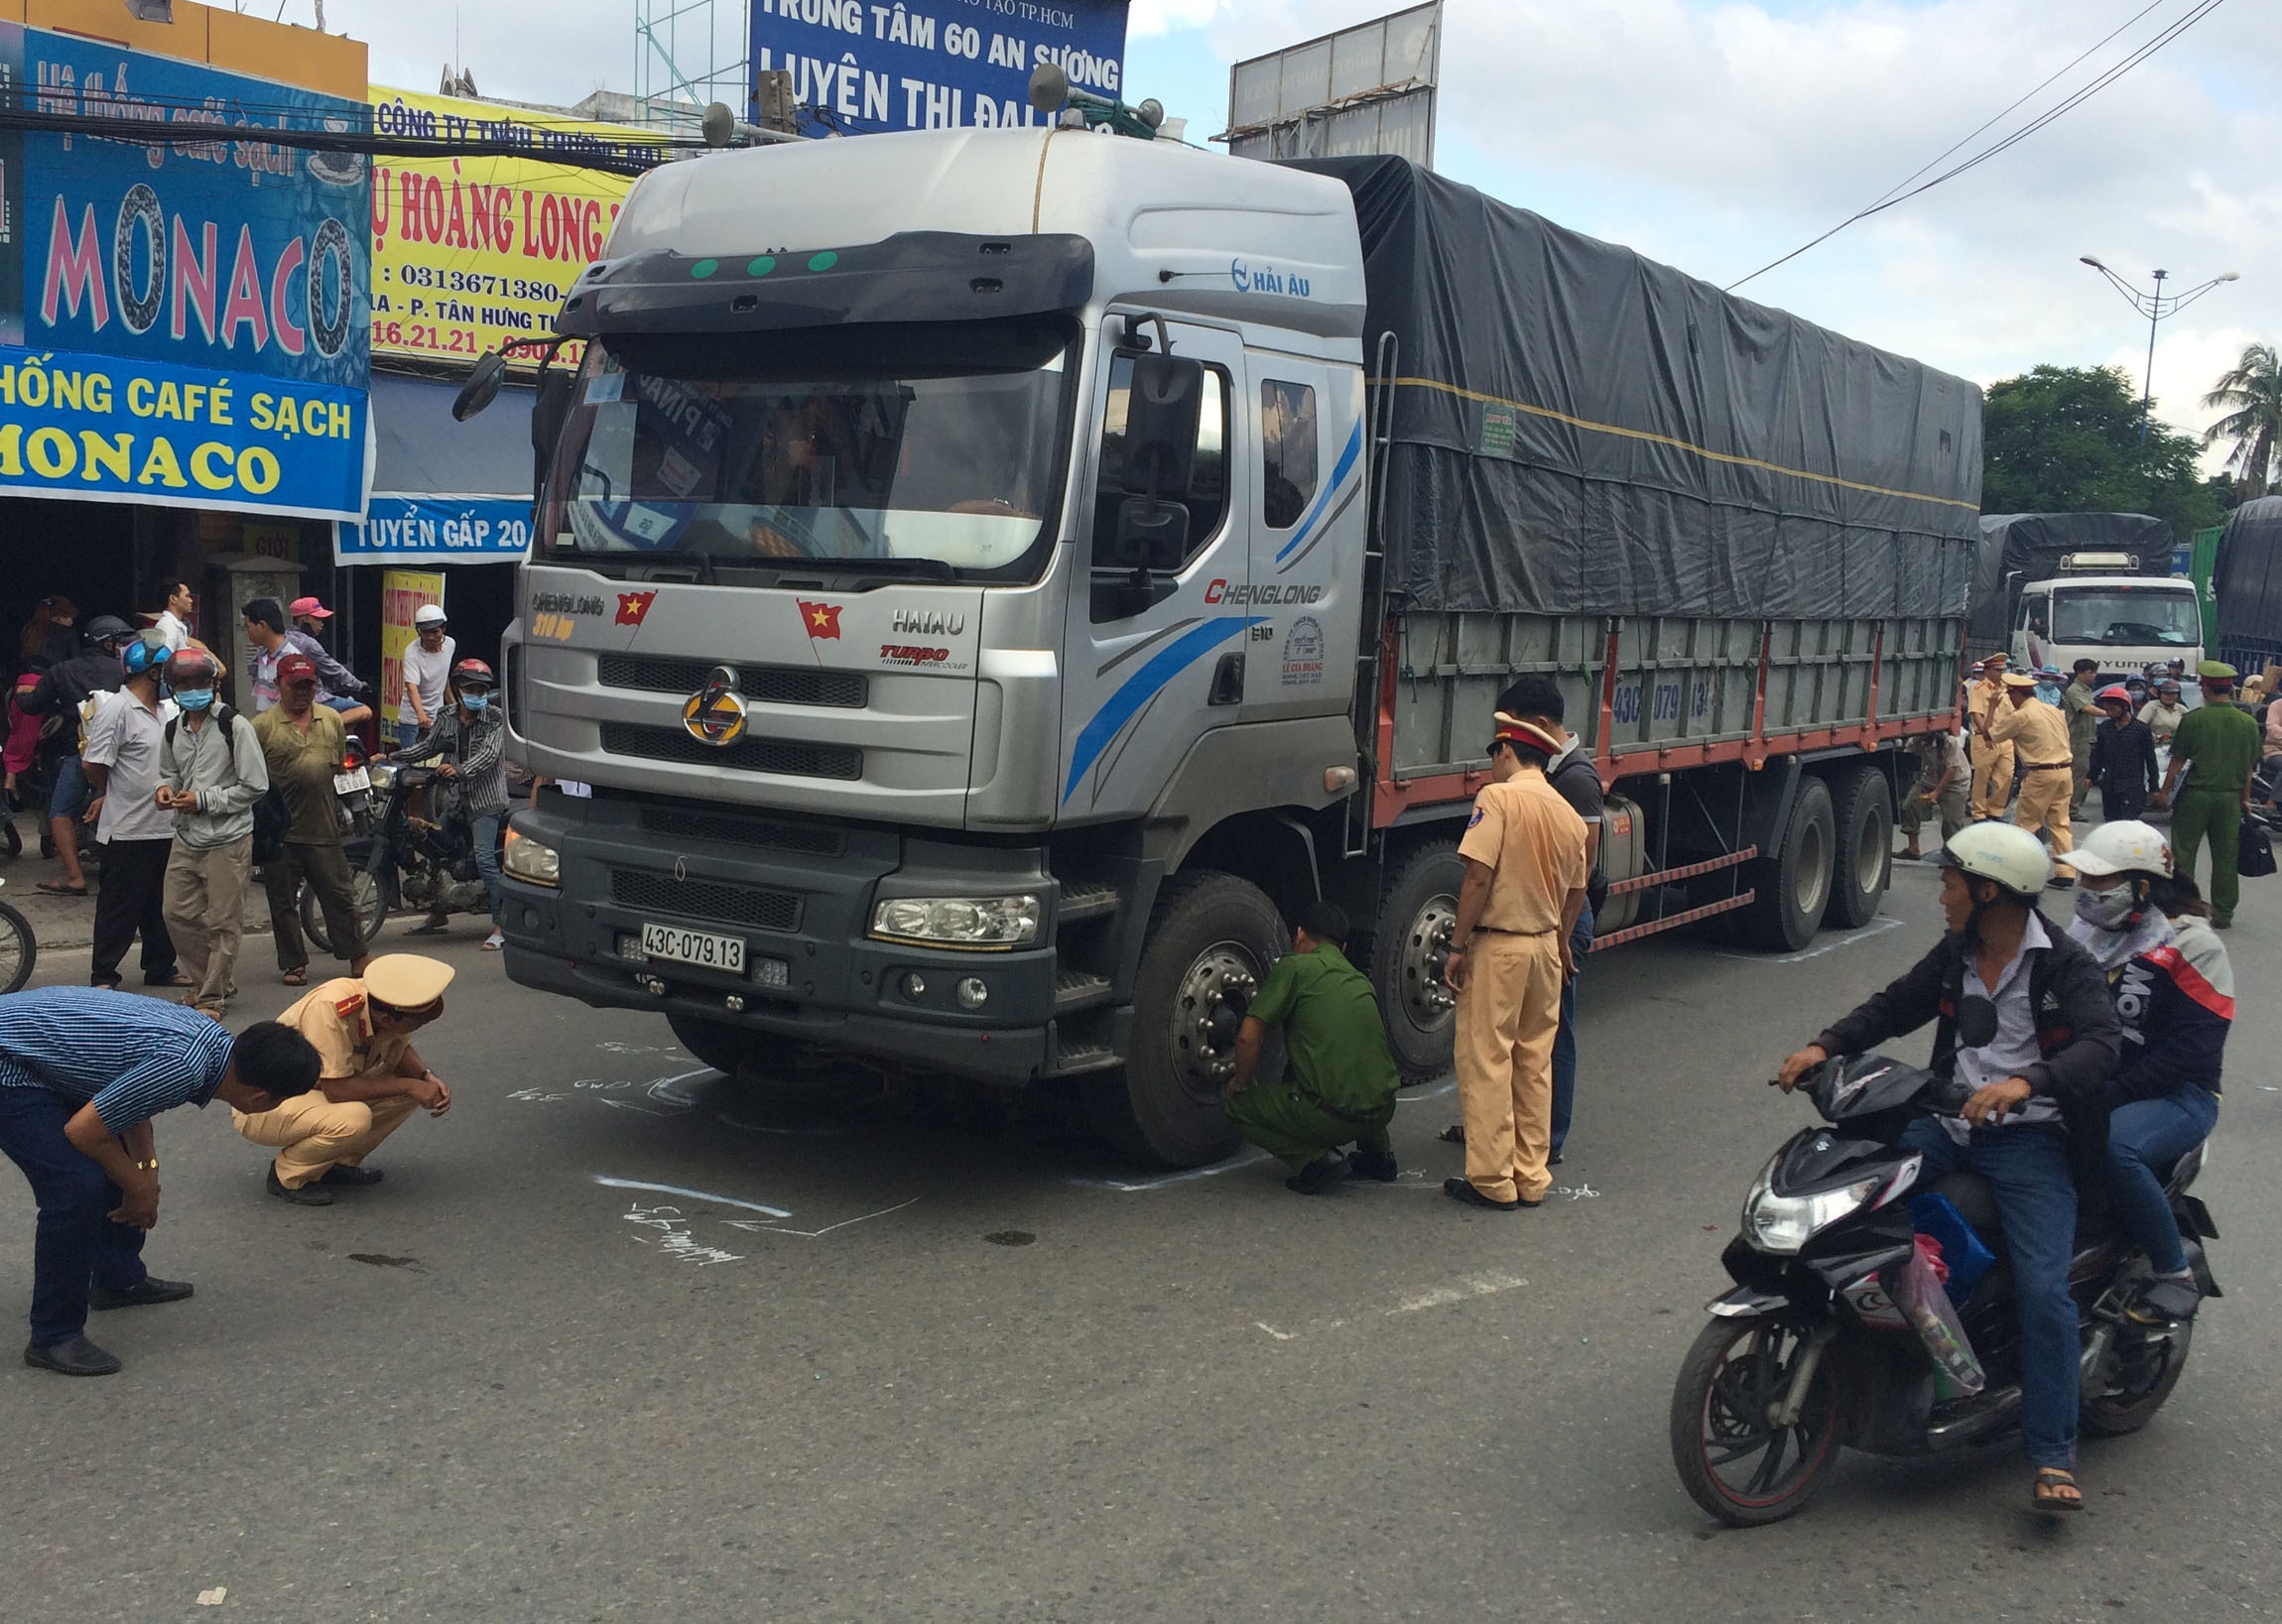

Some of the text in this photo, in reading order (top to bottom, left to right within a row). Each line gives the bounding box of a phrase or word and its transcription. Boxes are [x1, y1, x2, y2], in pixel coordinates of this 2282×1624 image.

[871, 2, 936, 50] TÂM
[944, 23, 980, 60] 60
[987, 34, 1025, 70] AN
[1019, 2, 1074, 30] TP.HCM
[377, 97, 437, 139] CÔNG
[443, 114, 469, 144] TY
[901, 77, 962, 129] THI
[522, 188, 603, 265] LONG
[41, 183, 352, 359] MONACO
[1252, 266, 1311, 298] HẢI ÂU
[436, 300, 474, 323] TÂN
[481, 307, 532, 330] HƯNG
[372, 319, 477, 354] 16.21.21
[127, 378, 234, 426] CAFÉ
[250, 392, 351, 440] SẠCH
[354, 505, 437, 547] TUYỂN
[443, 509, 490, 548] GẤP
[497, 519, 527, 547] 20
[1204, 578, 1322, 605] CHENGLONG
[880, 644, 950, 666] TURBO
[1652, 684, 1681, 720] 079
[644, 926, 741, 968] 43C-079.13
